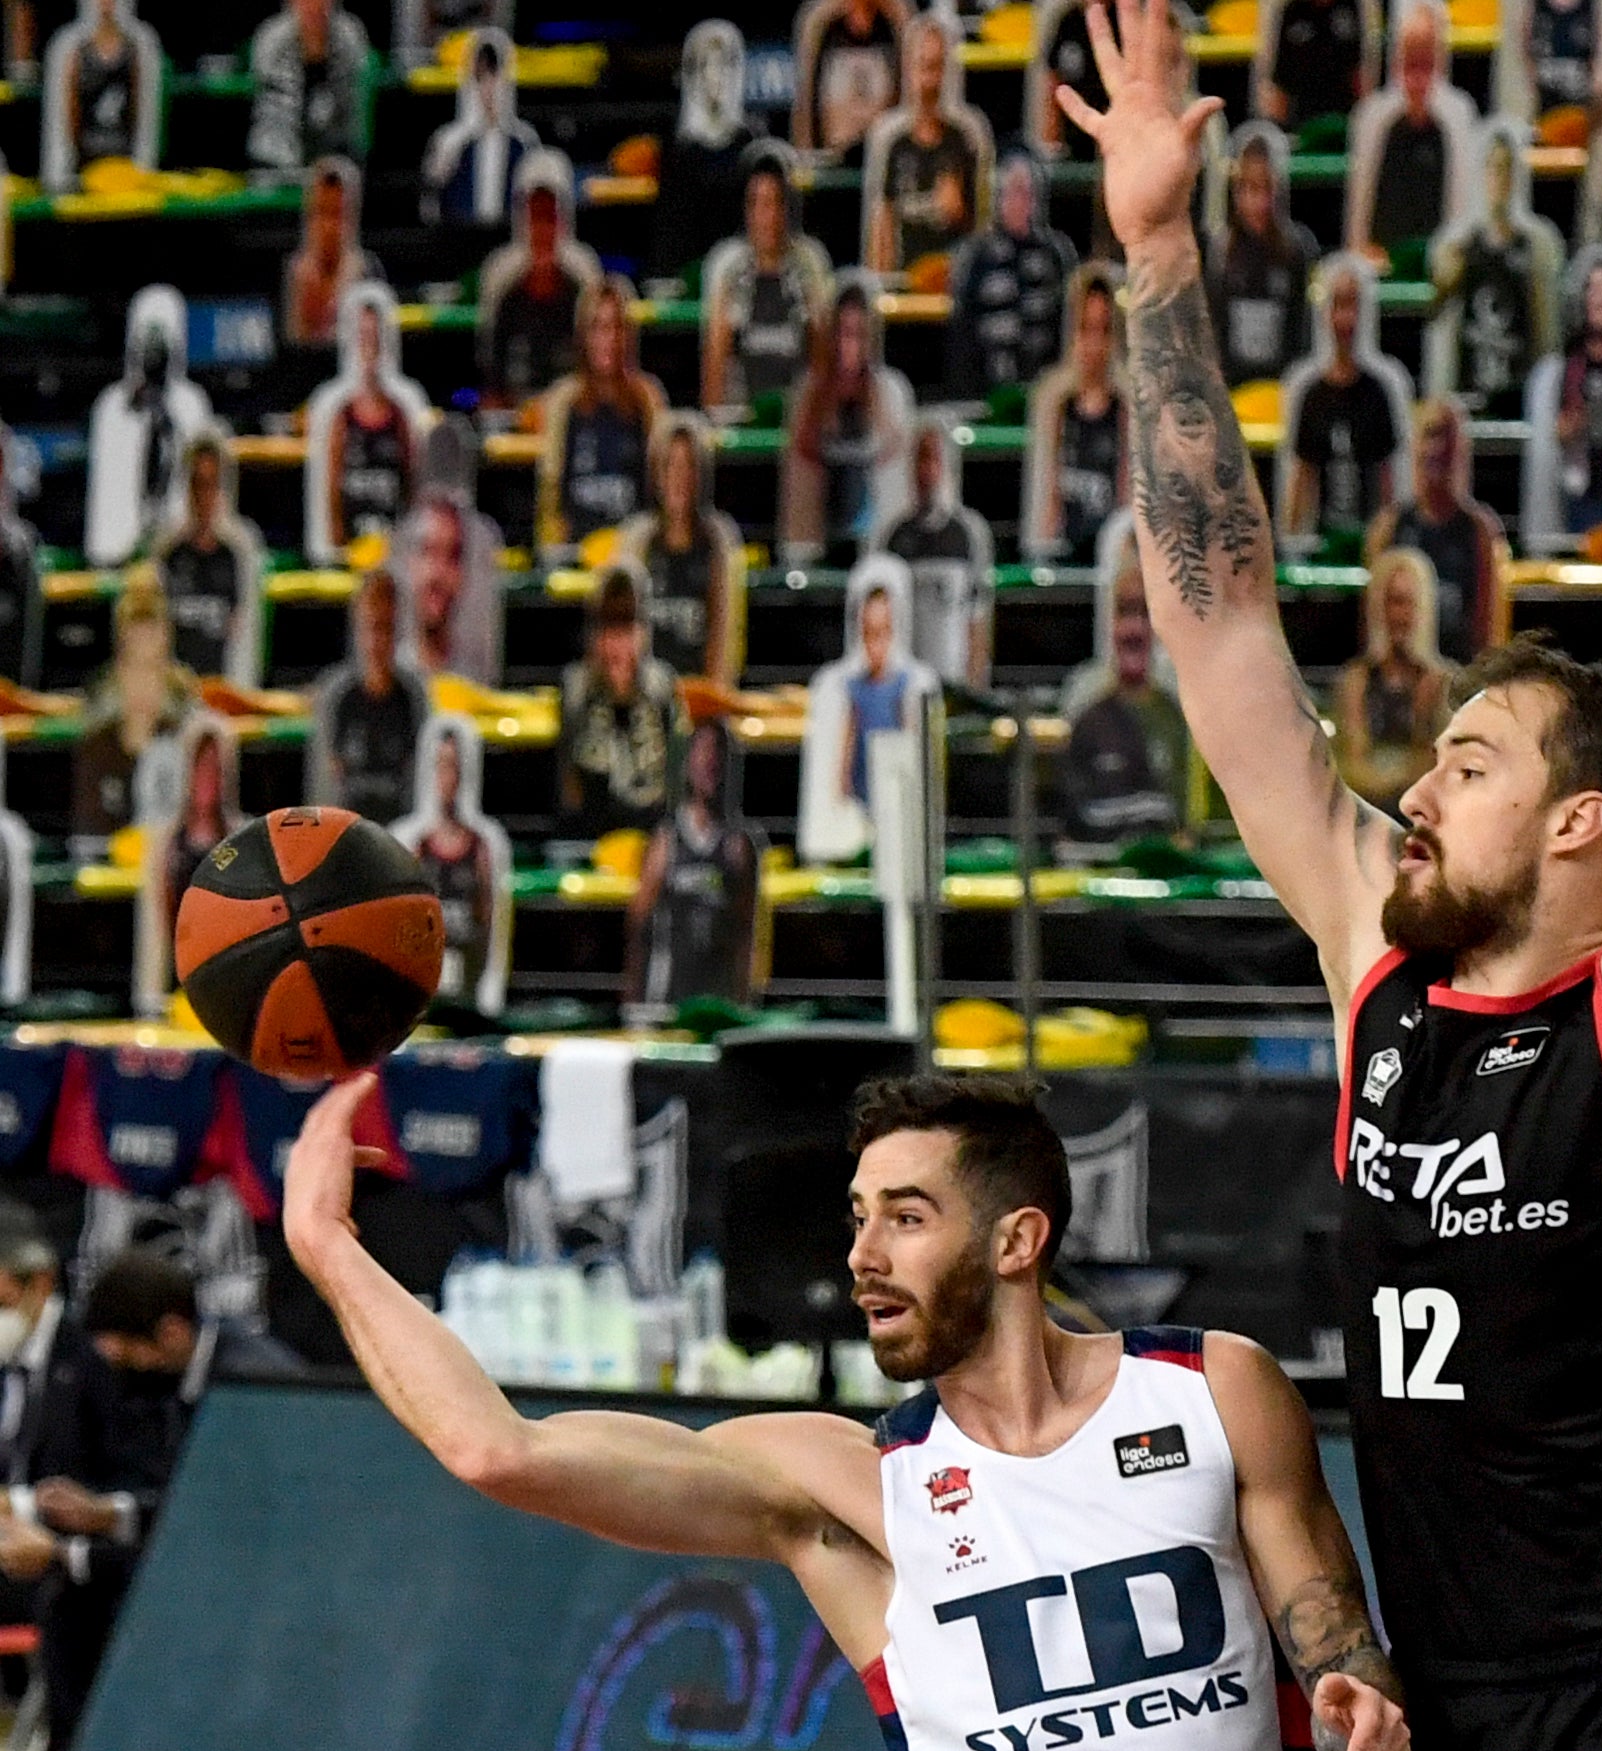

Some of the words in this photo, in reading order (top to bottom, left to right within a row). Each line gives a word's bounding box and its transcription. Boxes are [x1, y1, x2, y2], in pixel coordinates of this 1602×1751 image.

[1349, 1117, 1506, 1230] RETA
[1438, 1197, 1570, 1239] bet.es
[1372, 1286, 1465, 1401] 12
[1119, 1446, 1150, 1462] liga
[1123, 1451, 1186, 1474] endesa
[945, 1555, 988, 1574] KELME
[934, 1546, 1225, 1715] TD
